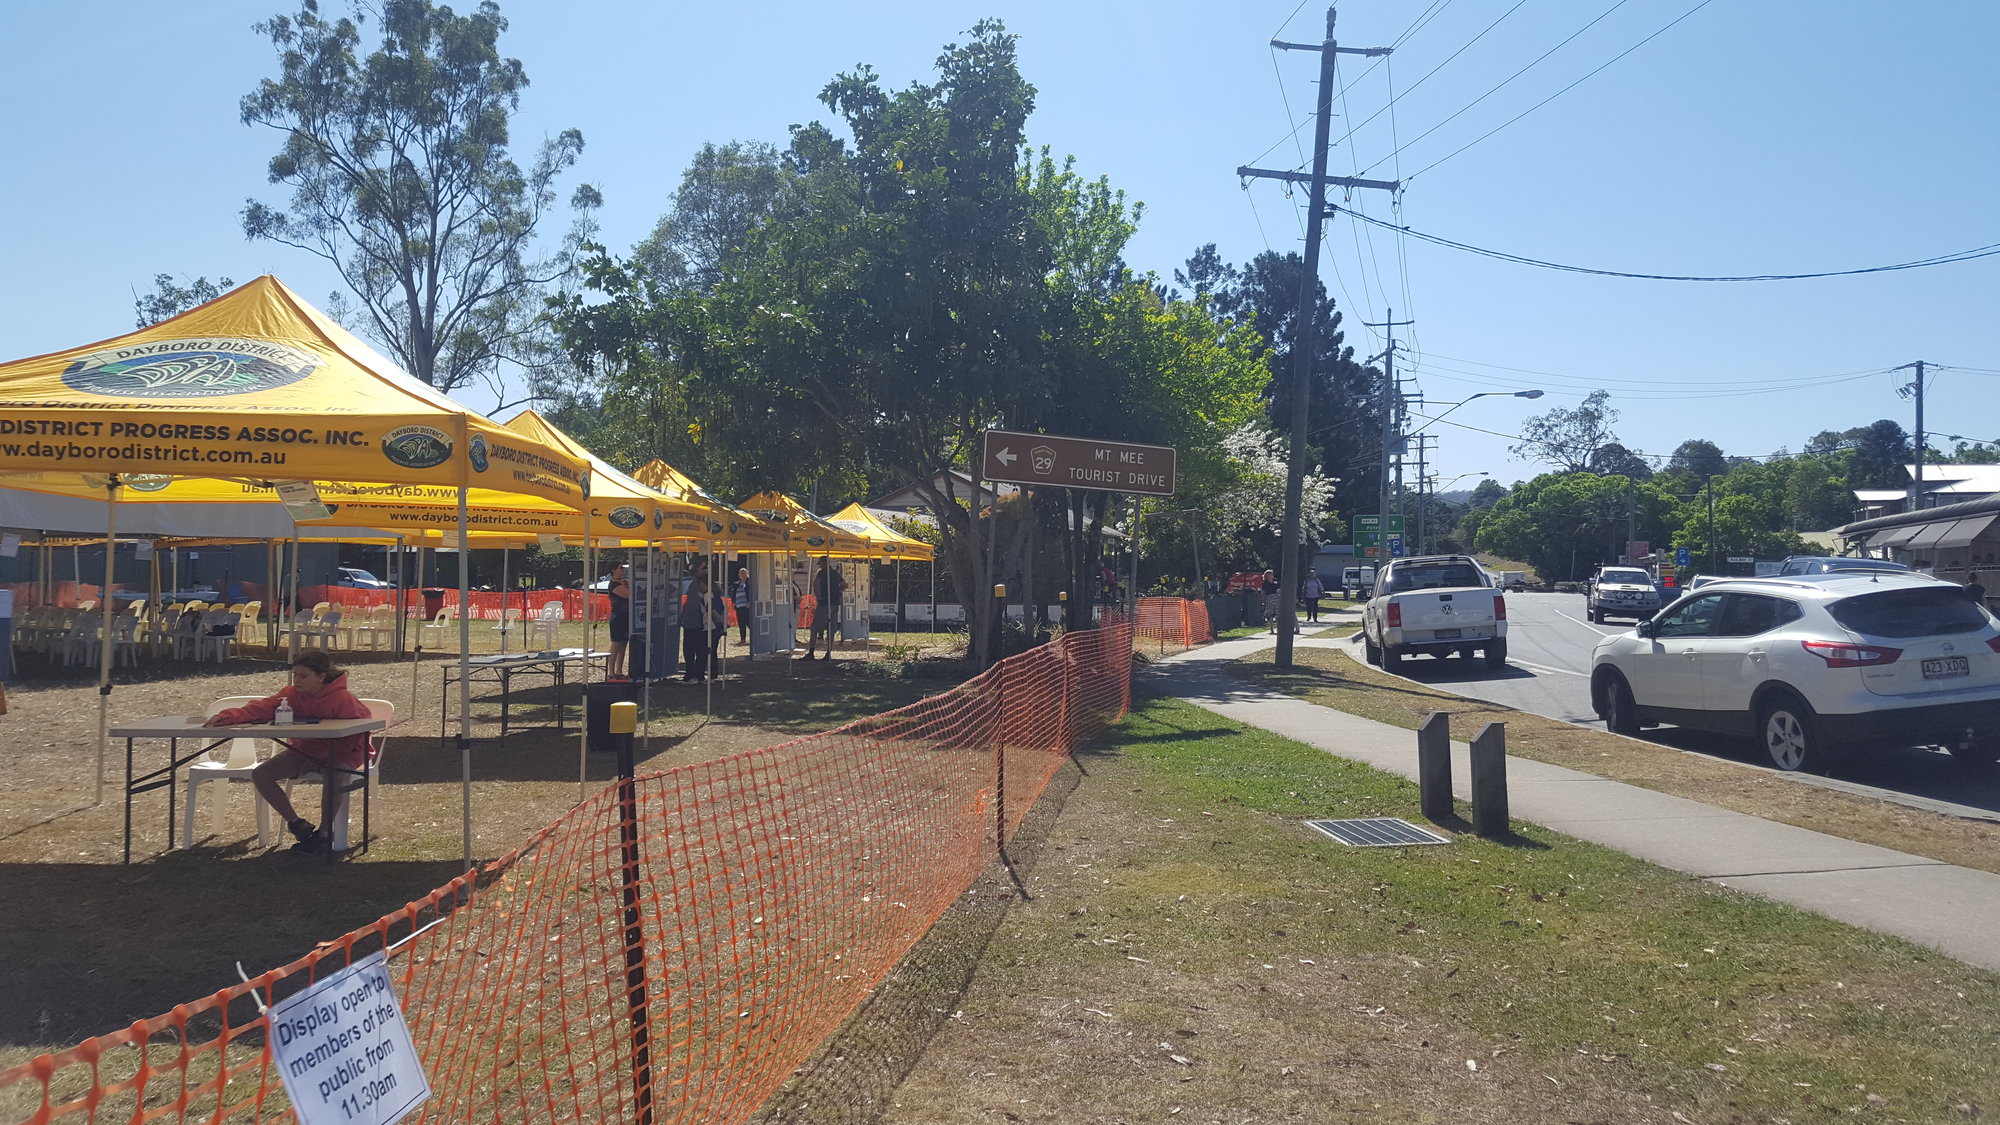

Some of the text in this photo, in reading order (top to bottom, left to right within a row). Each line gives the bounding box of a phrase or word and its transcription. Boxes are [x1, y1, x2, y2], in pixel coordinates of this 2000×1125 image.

[116, 340, 297, 361] DAYBORO DISTRICT
[0, 419, 369, 447] DISTRICT PROGRESS ASSOC. INC.
[0, 440, 286, 465] w.dayborodistrict.com.au
[490, 444, 517, 462] DAYBORO
[516, 450, 539, 467] DISTRICT
[1035, 457, 1052, 470] 29
[1094, 448, 1145, 465] MT MEE
[1069, 467, 1166, 488] TOURIST DRIVE
[390, 512, 558, 527] www.dayboodistrict.com.au
[1925, 662, 1942, 674] 423
[277, 974, 385, 1047] Display open to
[289, 1001, 396, 1078] members of the
[317, 1036, 395, 1103] public from
[341, 1071, 398, 1120] 11.30am
